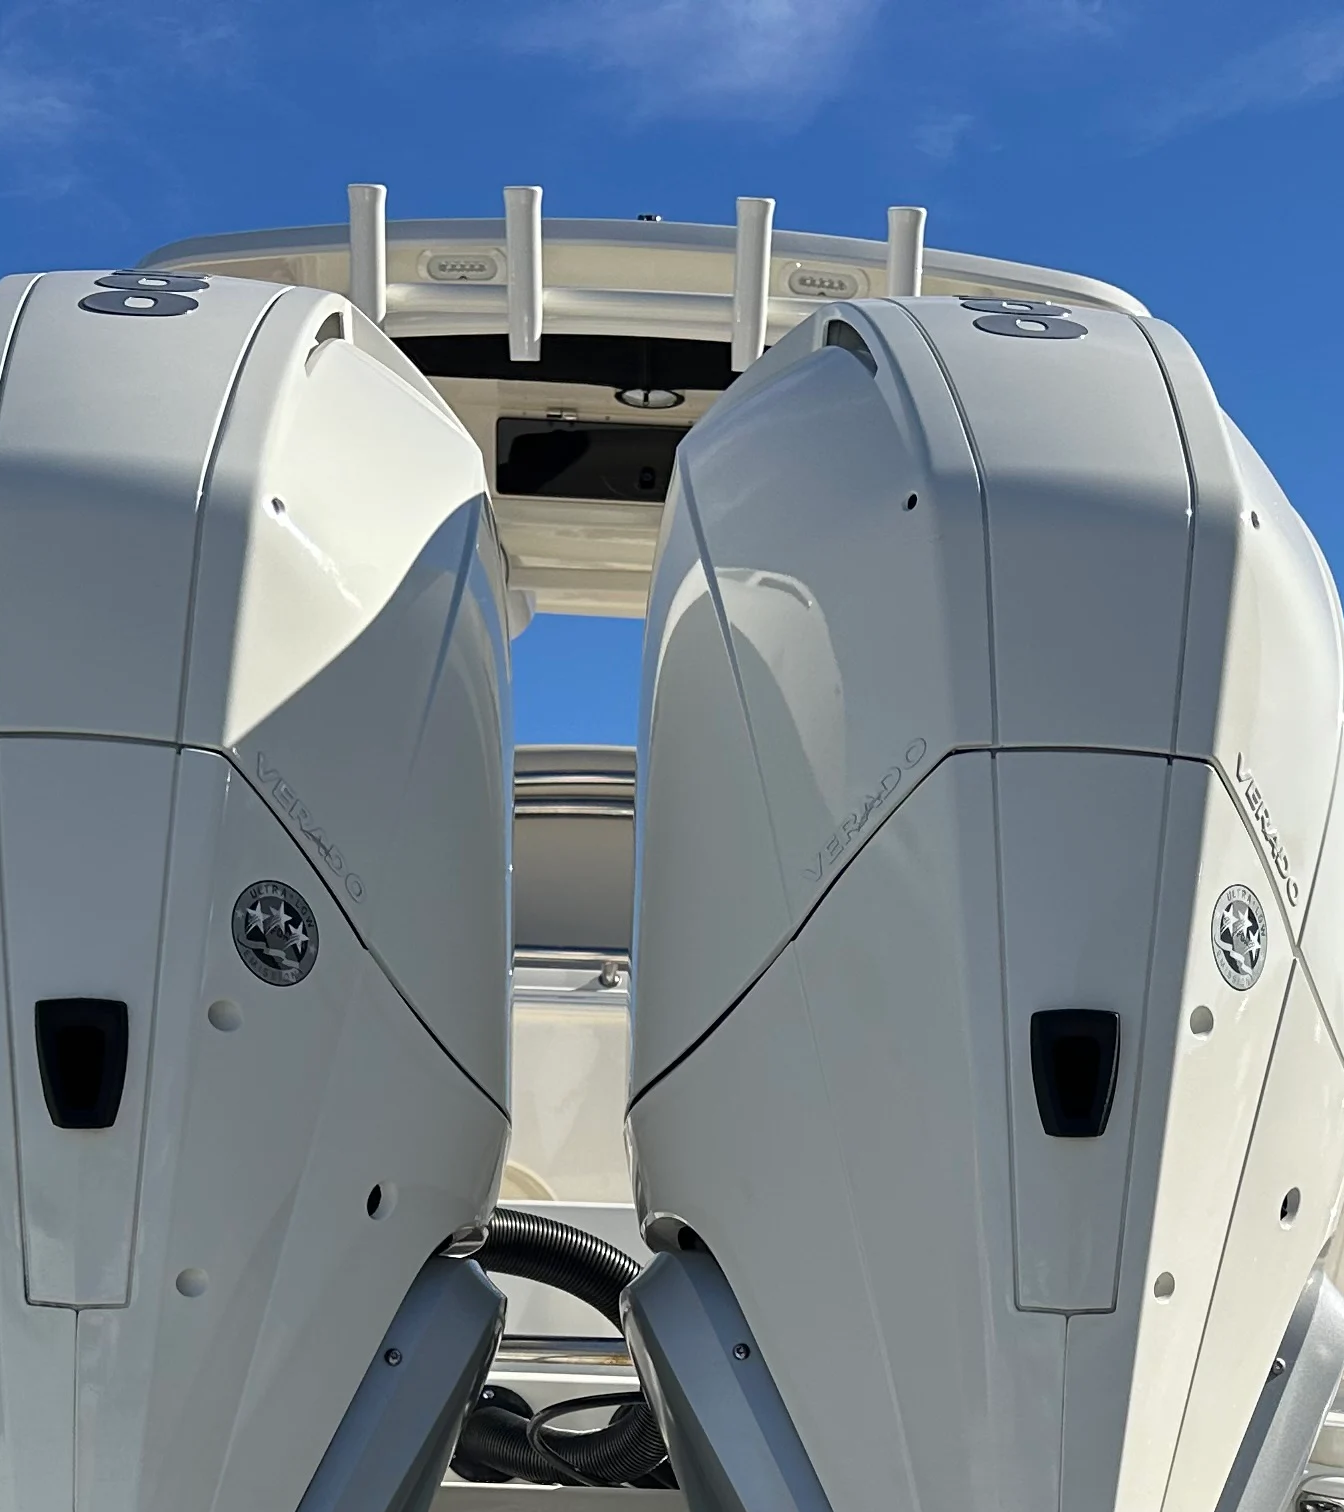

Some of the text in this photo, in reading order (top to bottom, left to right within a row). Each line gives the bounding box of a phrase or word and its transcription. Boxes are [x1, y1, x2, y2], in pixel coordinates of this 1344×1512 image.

[257, 751, 368, 904] VERADO
[800, 737, 928, 882] VERADO
[1236, 751, 1299, 908] VERADO
